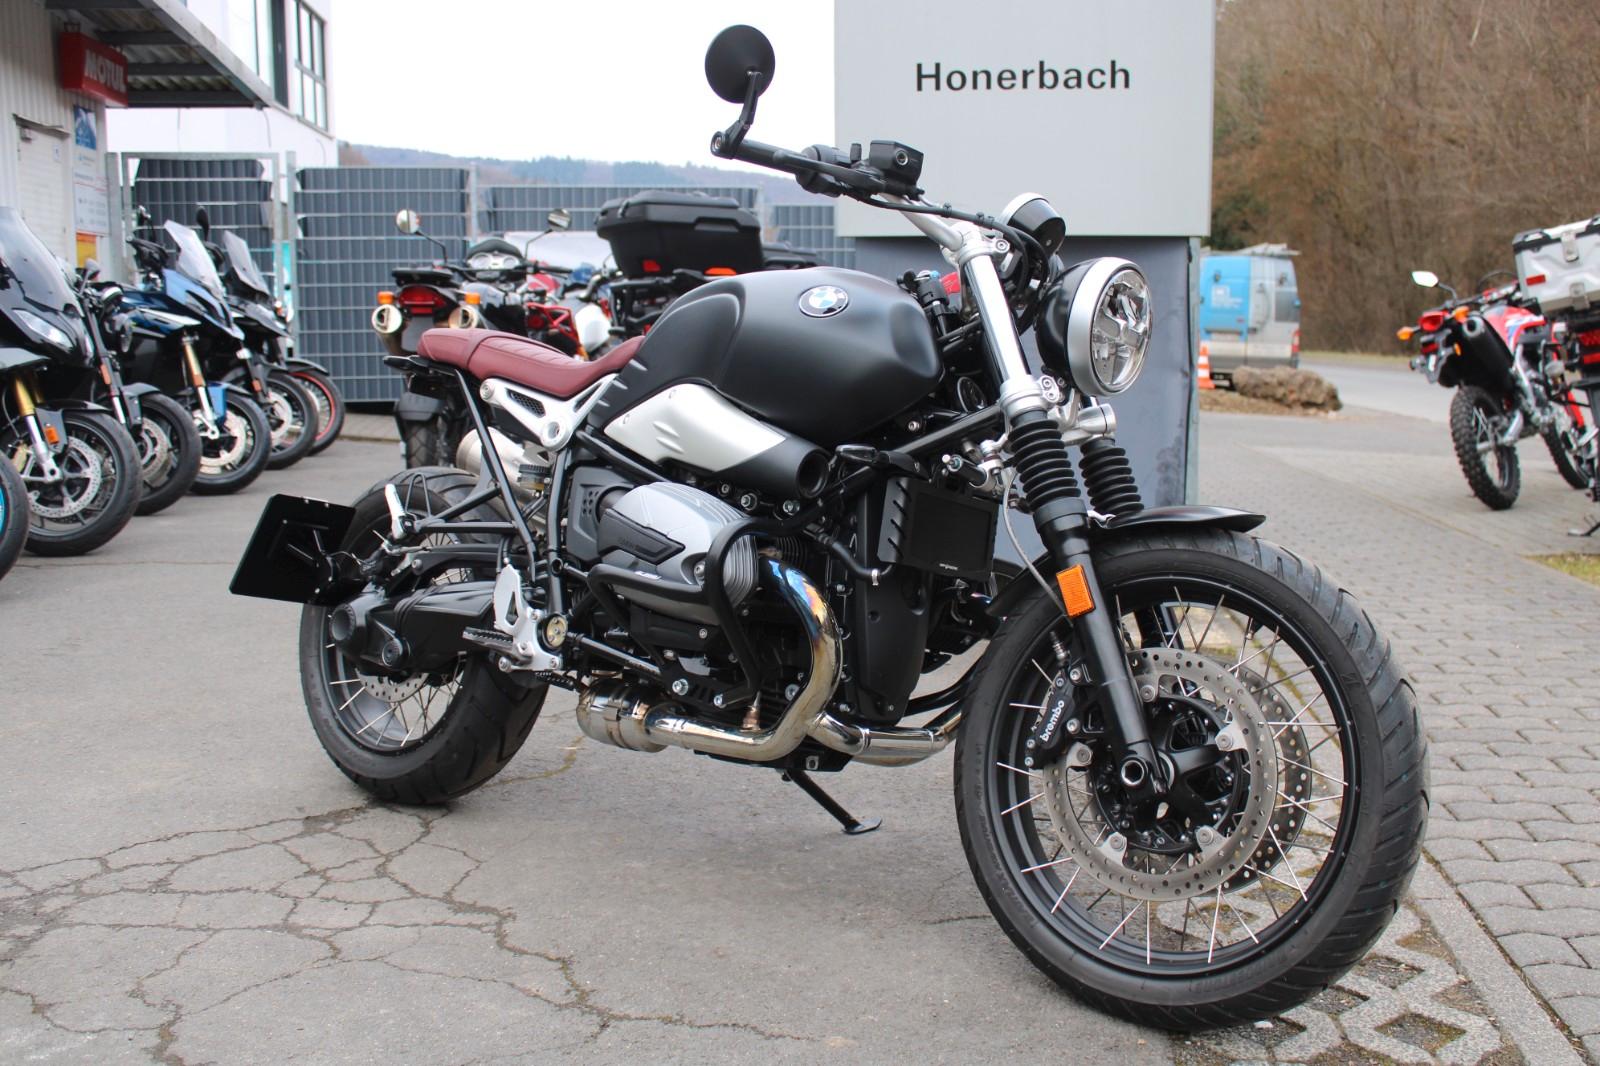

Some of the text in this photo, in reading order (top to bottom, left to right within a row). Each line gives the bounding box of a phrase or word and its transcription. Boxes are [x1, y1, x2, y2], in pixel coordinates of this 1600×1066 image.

[84, 48, 127, 94] MOTUL
[915, 60, 1131, 92] Honerbach
[1040, 700, 1065, 742] brembo
